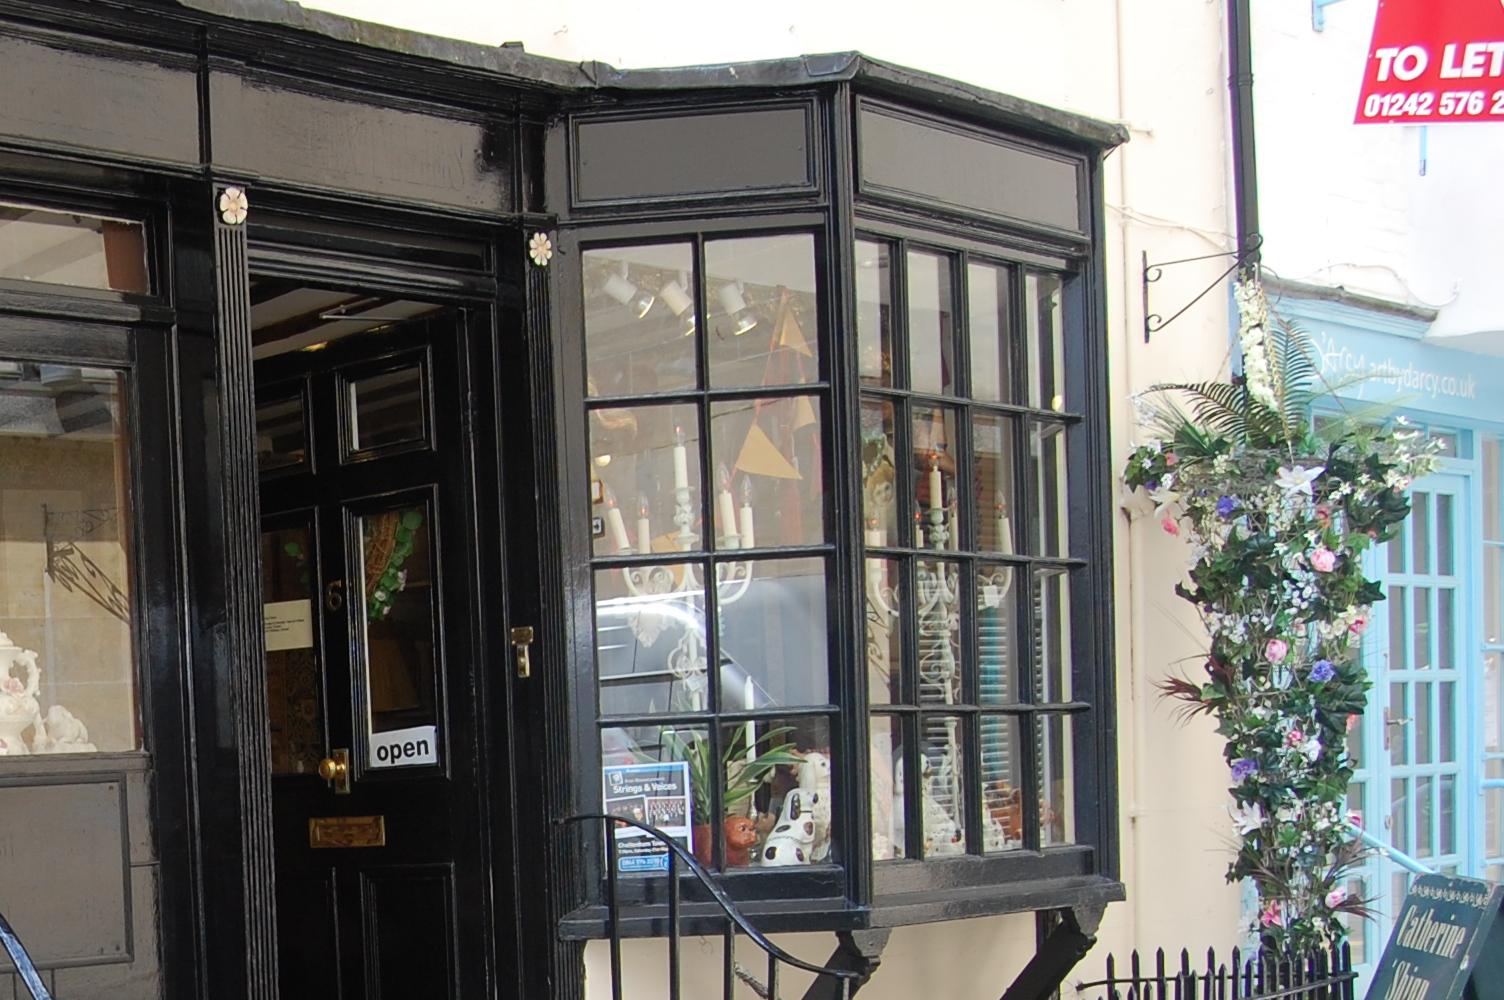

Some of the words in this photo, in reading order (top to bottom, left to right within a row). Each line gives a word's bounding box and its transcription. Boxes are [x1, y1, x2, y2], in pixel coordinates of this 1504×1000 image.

[1375, 45, 1428, 82] TO
[1439, 41, 1504, 79] LET
[1363, 91, 1432, 117] 01242
[1438, 90, 1484, 116] 576
[1369, 357, 1476, 399] artbydarcy.co.uk
[376, 739, 430, 765] open
[613, 785, 643, 795] Strings
[644, 783, 651, 791] &
[651, 782, 678, 792] Voices
[1397, 904, 1466, 959] Catherine
